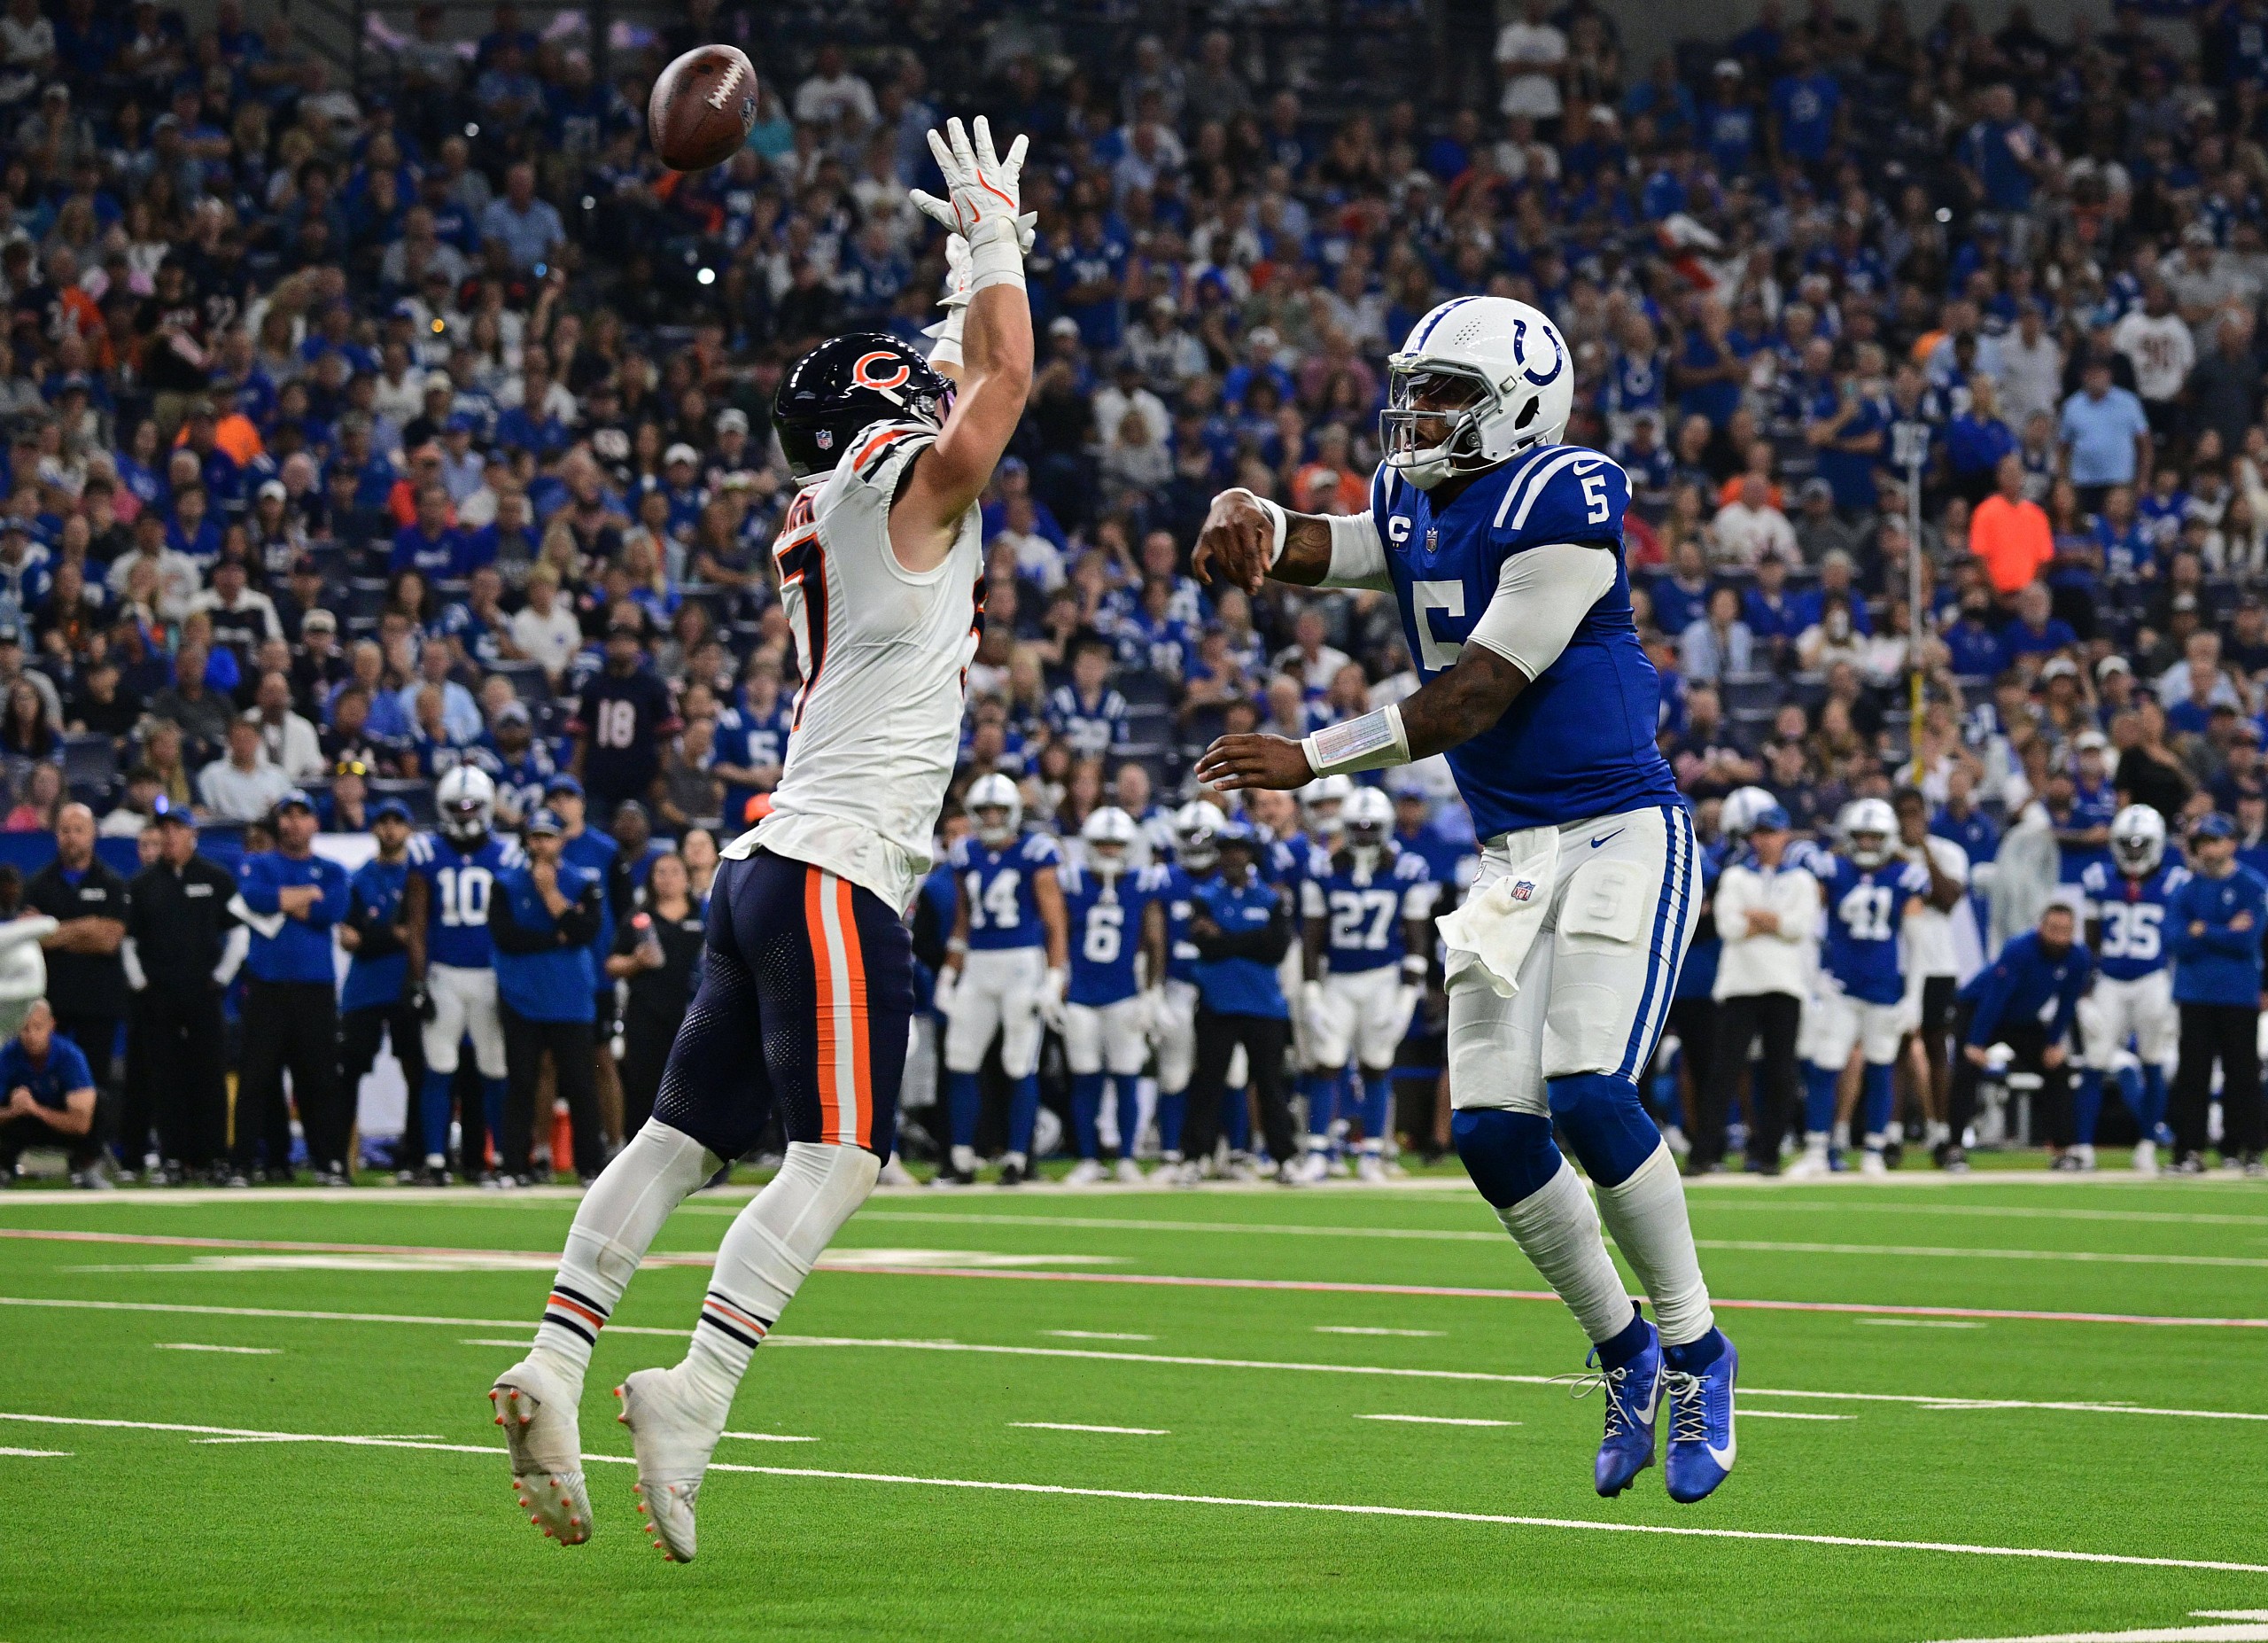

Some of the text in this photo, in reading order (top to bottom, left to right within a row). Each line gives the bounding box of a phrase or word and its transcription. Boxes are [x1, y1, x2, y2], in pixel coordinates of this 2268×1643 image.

[1388, 516, 1411, 541] C
[1581, 475, 1610, 525] 5
[1412, 580, 1465, 671] 5
[598, 698, 636, 747] 18
[748, 713, 780, 765] 5
[437, 866, 493, 927] 10
[965, 868, 1021, 930] 14
[1330, 889, 1397, 951] 27
[1511, 885, 1532, 900] NFL
[1838, 884, 1892, 941] 41
[1084, 905, 1124, 963] 6
[2101, 900, 2164, 960] 35
